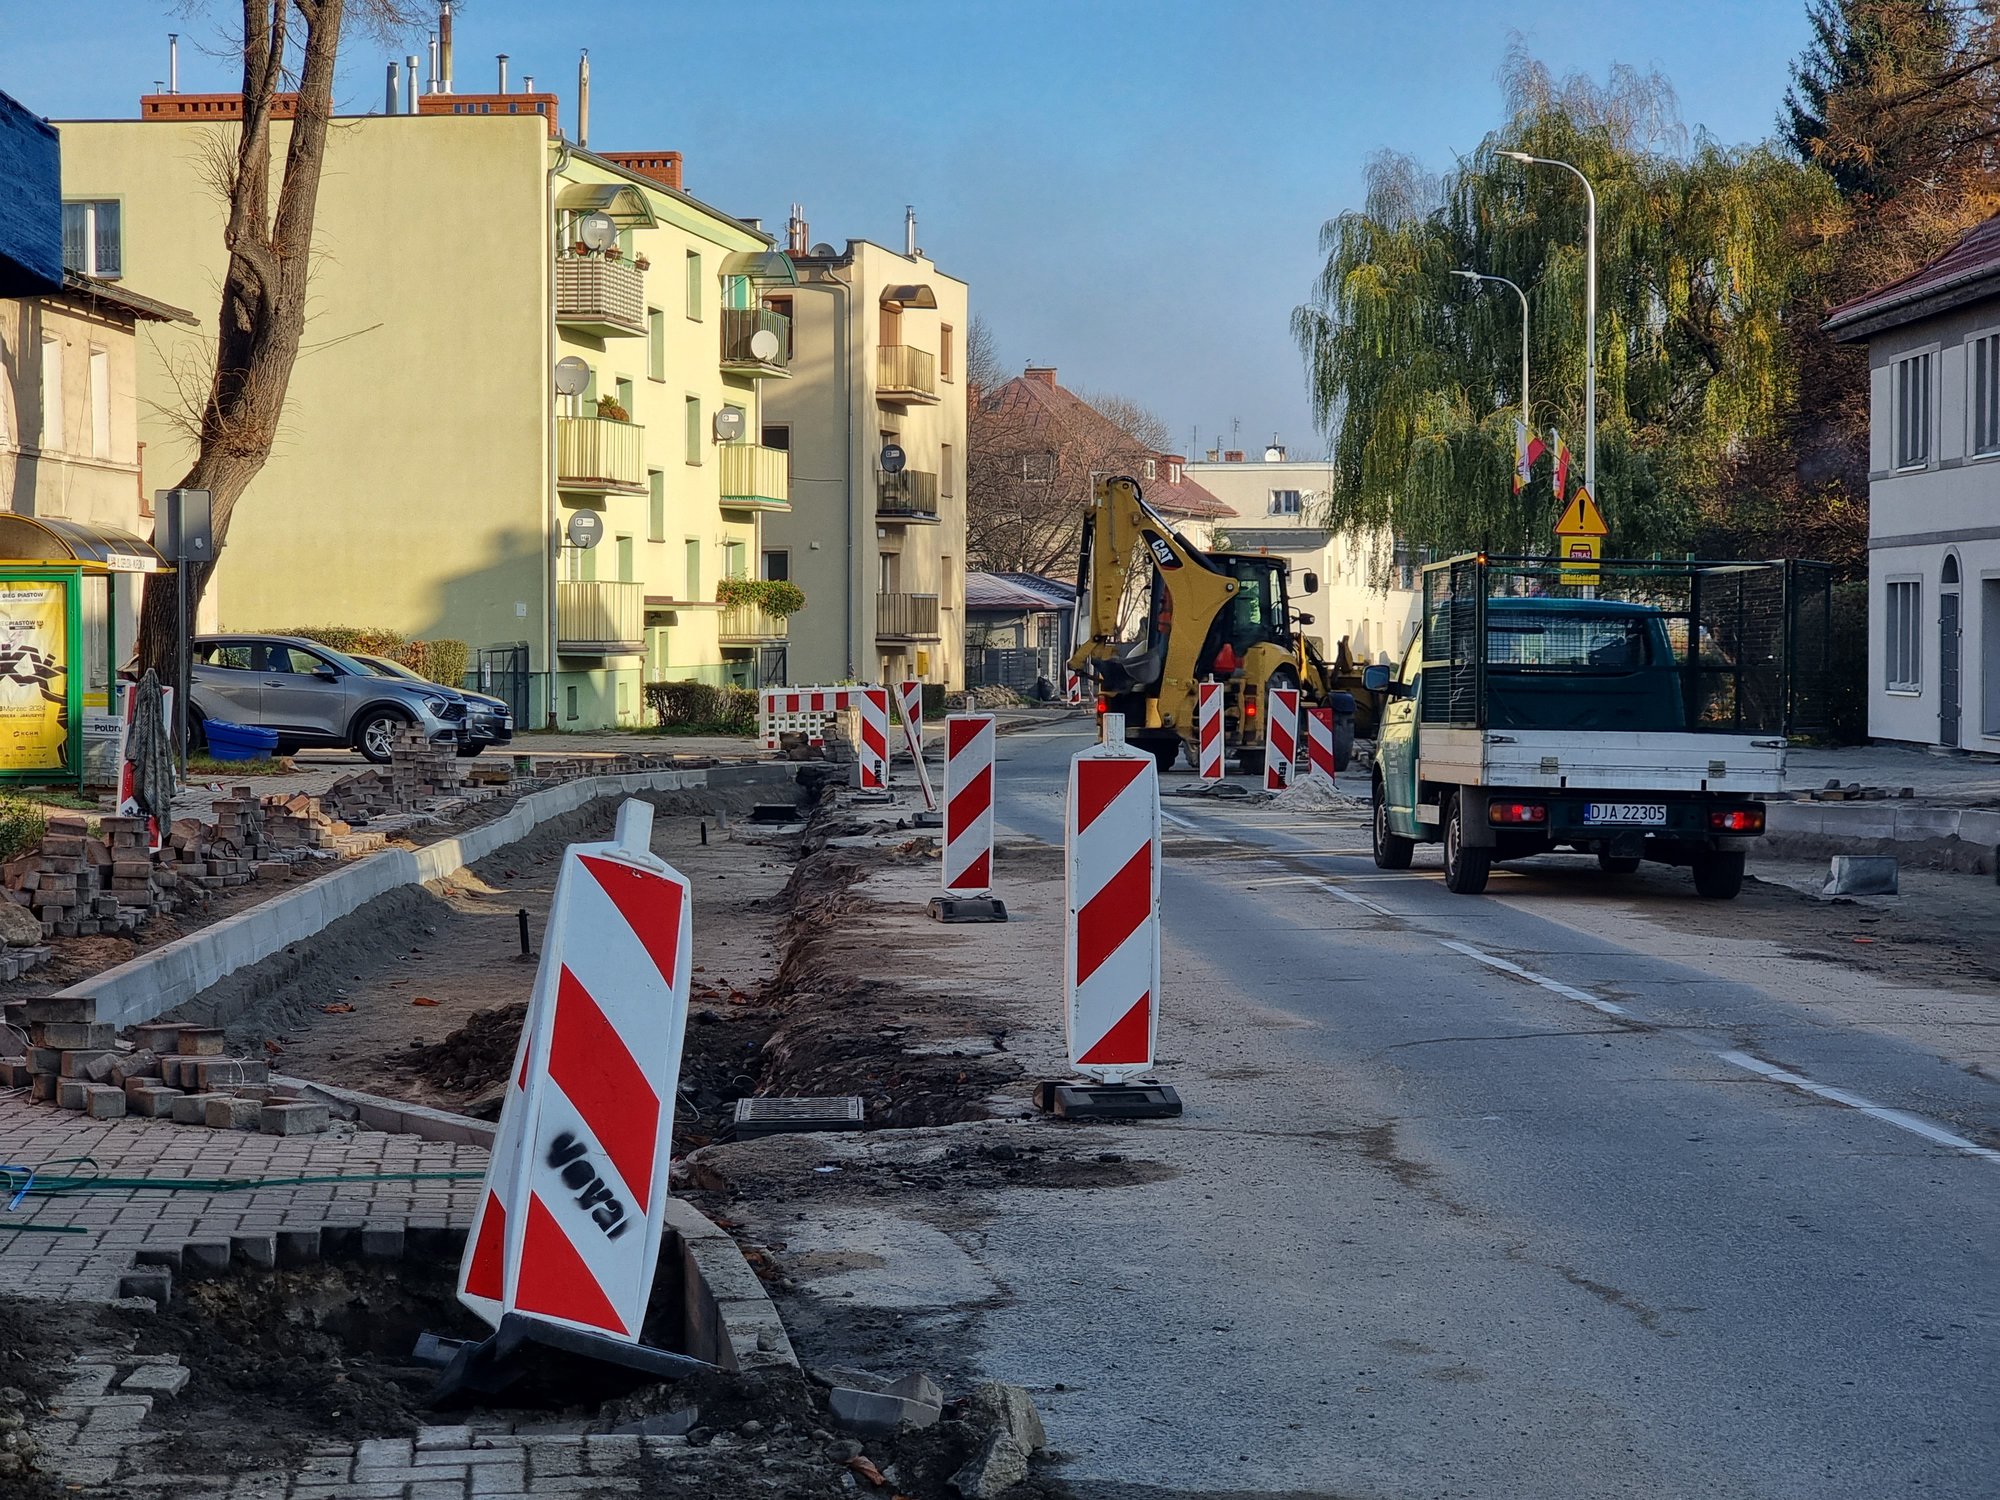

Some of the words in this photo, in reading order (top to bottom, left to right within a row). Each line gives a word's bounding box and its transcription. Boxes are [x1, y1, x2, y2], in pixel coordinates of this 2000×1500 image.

[1151, 539, 1174, 564] CAT
[1591, 805, 1618, 820] DJA
[1622, 805, 1665, 820] 22305
